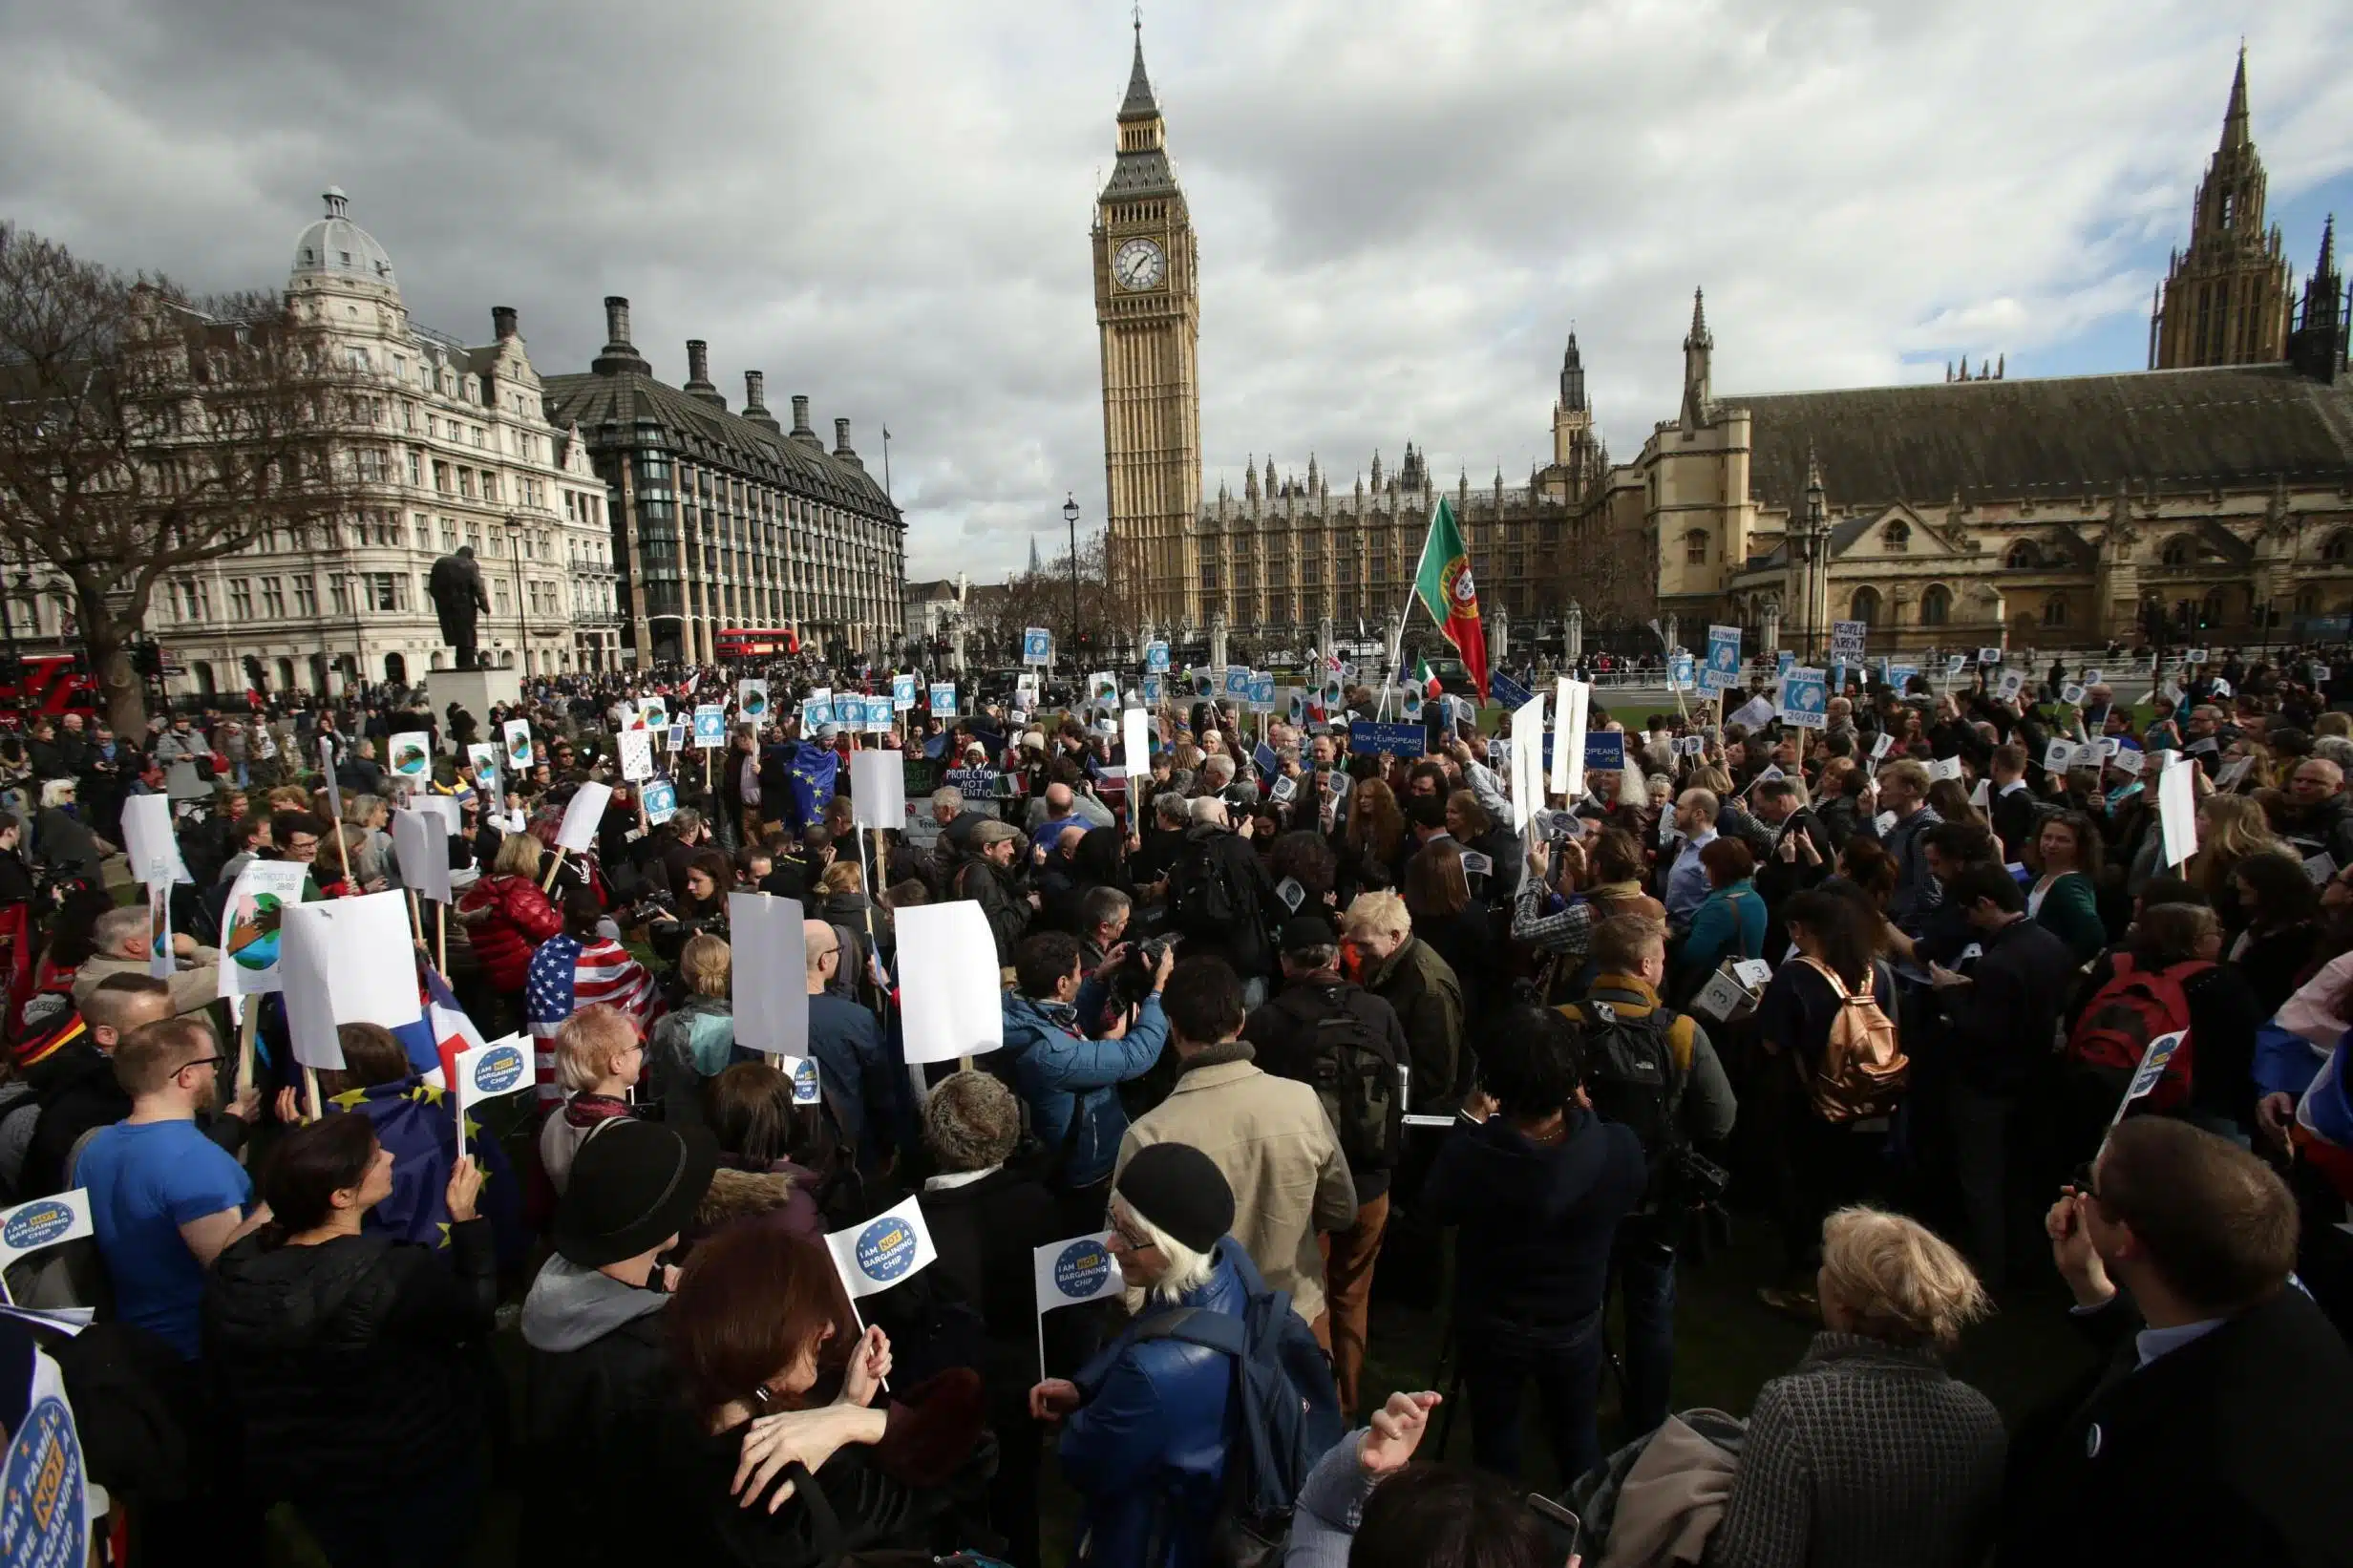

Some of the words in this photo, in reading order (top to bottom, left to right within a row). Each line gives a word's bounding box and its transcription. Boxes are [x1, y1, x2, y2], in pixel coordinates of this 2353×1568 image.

[1834, 623, 1864, 635] PEOPLE
[1787, 710, 1822, 724] 20/02
[1354, 733, 1371, 742] NEW
[1376, 734, 1422, 745] EUROPEANS
[1542, 746, 1554, 754] NE
[946, 769, 1000, 780] PROTECTION
[1940, 765, 1950, 776] 3
[961, 779, 985, 789] NOT
[963, 788, 994, 798] ENTIO
[1751, 965, 1765, 979] 3
[1713, 989, 1728, 1004] 3
[477, 1065, 520, 1082] BARGAINING
[490, 1075, 509, 1085] CHIP
[9, 1217, 69, 1241] BARGAINING
[12, 1222, 27, 1233] AM
[27, 1228, 52, 1240] CHIP
[864, 1245, 879, 1258] AM
[880, 1232, 901, 1250] NOT
[903, 1229, 910, 1239] A
[863, 1238, 913, 1268] BARGAINING
[882, 1255, 902, 1270] CHIP
[1063, 1262, 1075, 1273] AM
[1078, 1255, 1096, 1267] NOT
[1100, 1256, 1106, 1264] A
[1059, 1265, 1107, 1282] BARGAINING
[1074, 1278, 1093, 1288] CHIP
[4, 1493, 23, 1545] MY
[24, 1406, 60, 1498] FAMILY
[11, 1525, 37, 1568] RE
[37, 1445, 61, 1521] NOT
[63, 1429, 71, 1452] A
[34, 1451, 77, 1568] RGAINING
[53, 1519, 74, 1568] HIP
